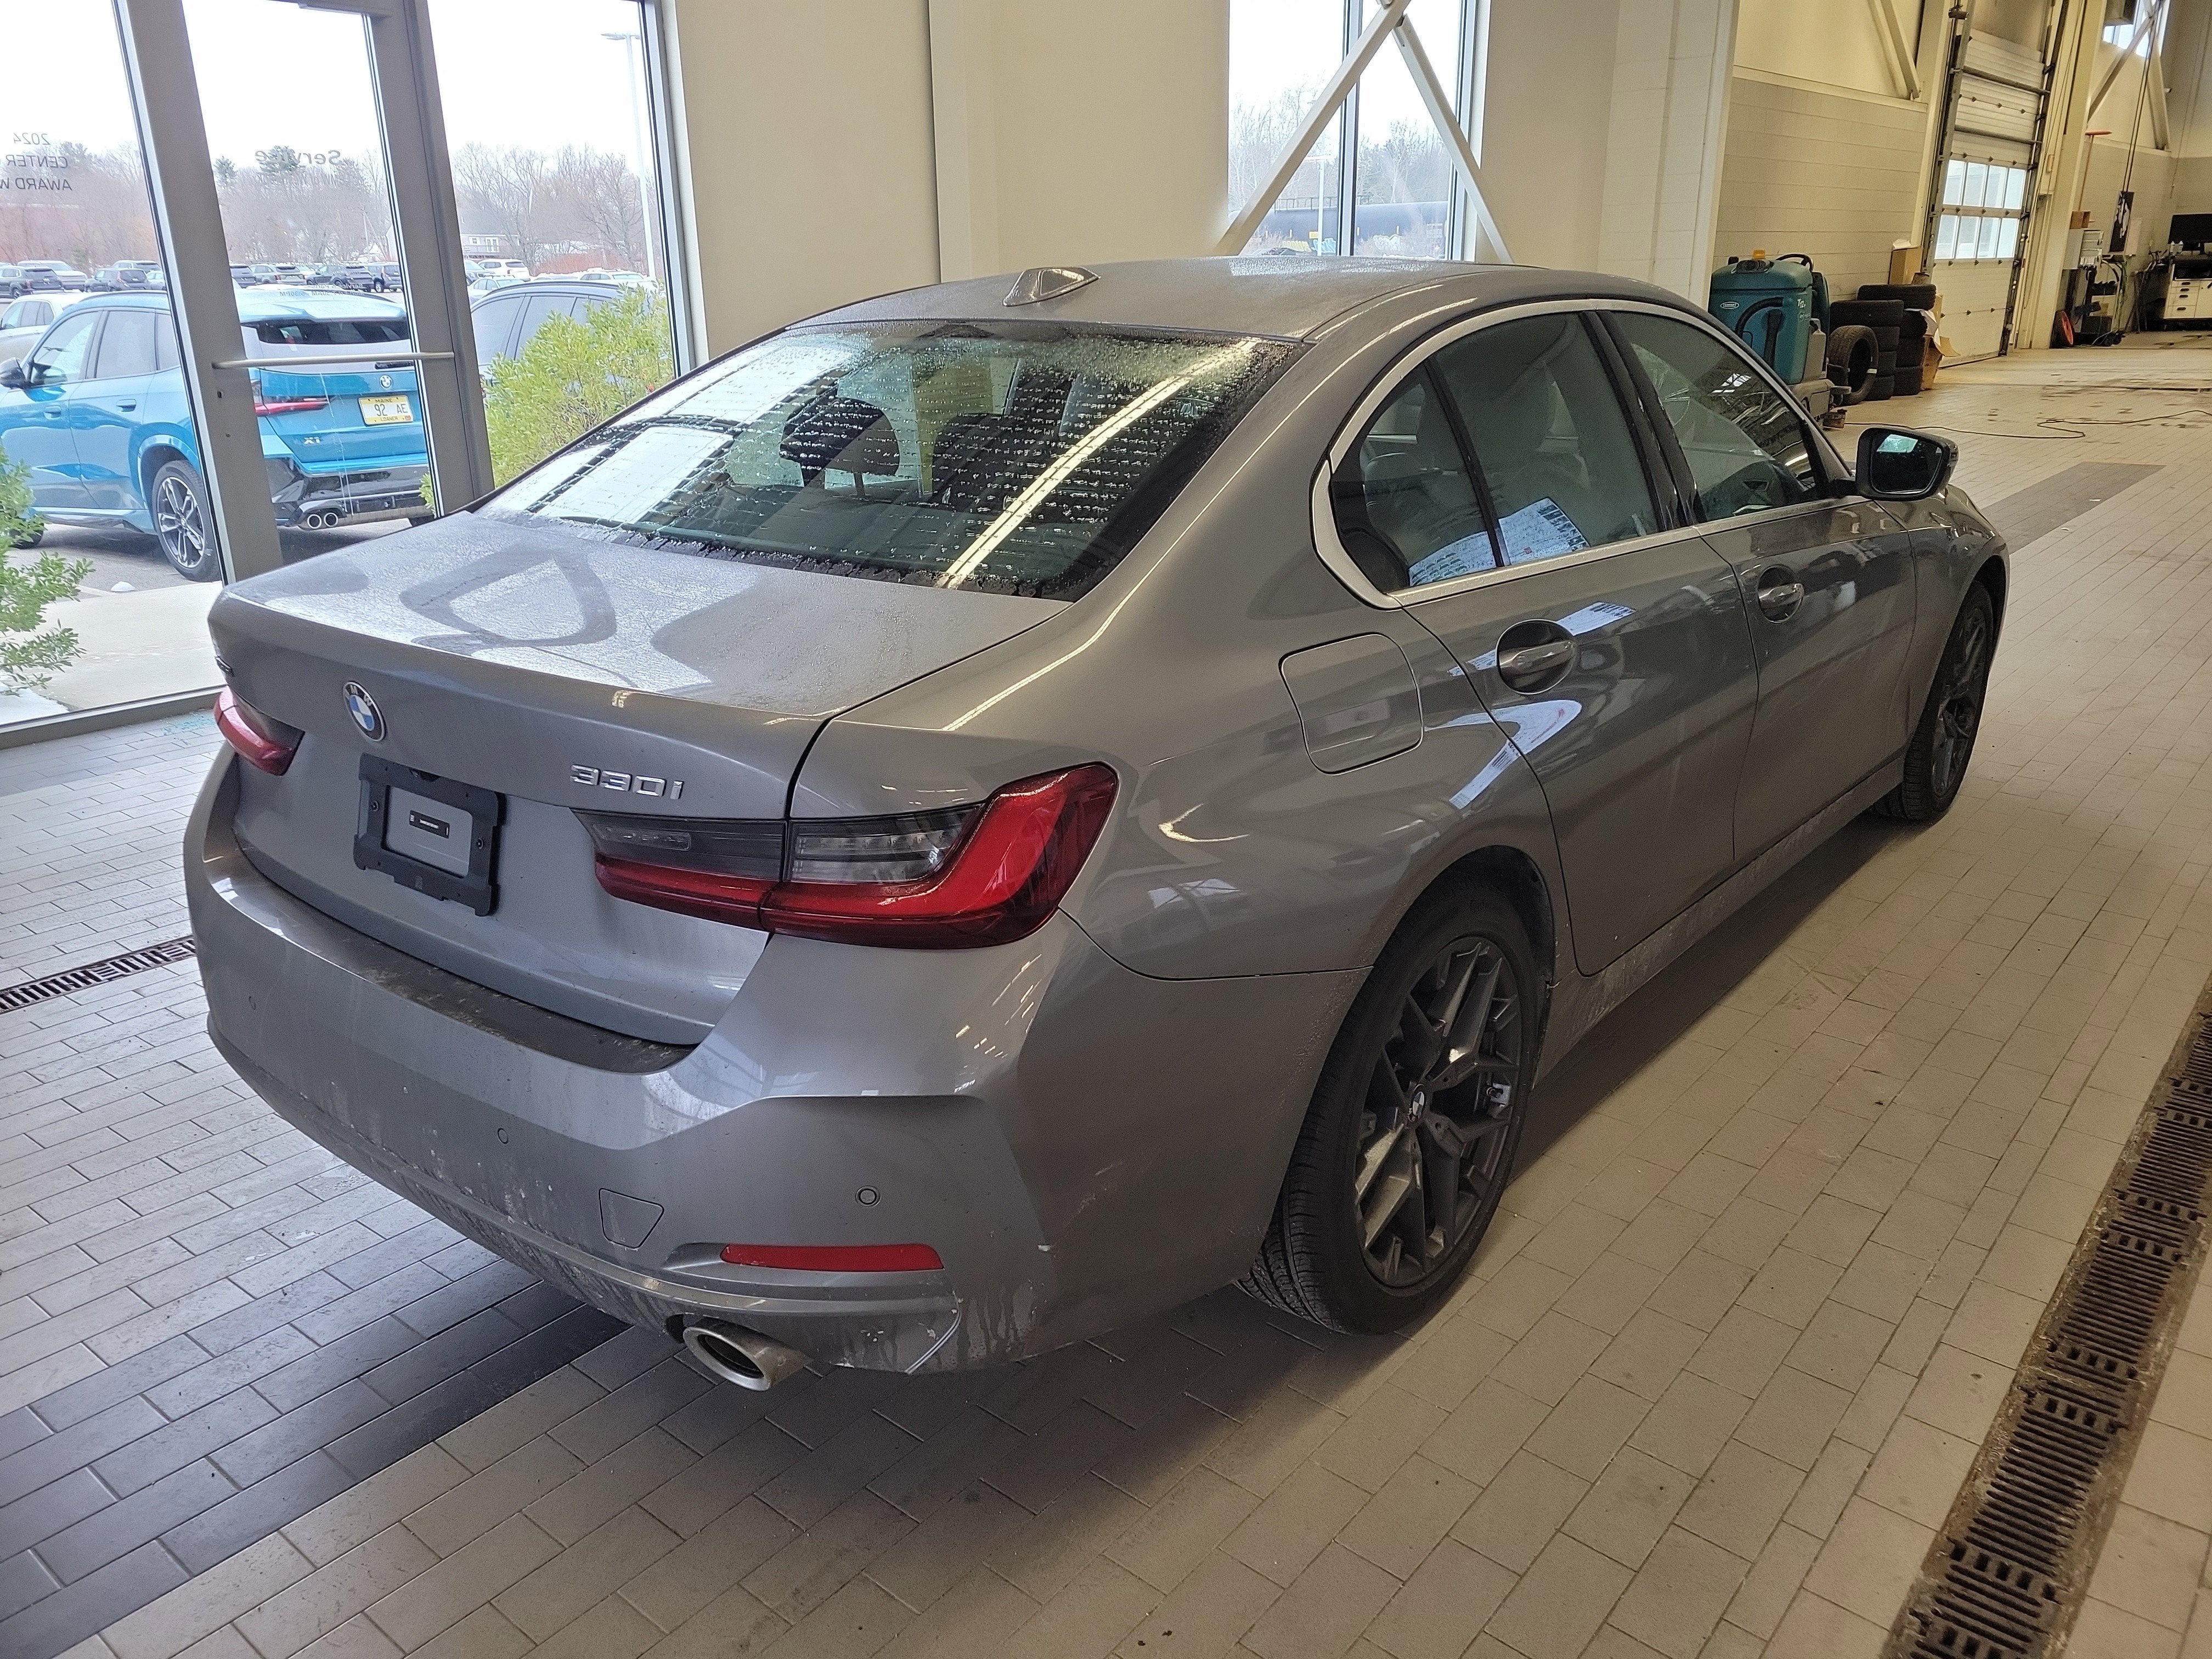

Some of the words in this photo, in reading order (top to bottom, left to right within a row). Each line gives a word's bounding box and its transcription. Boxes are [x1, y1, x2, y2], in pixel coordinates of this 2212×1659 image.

[374, 404, 387, 416] 92
[396, 404, 408, 414] AE
[303, 436, 320, 444] X1
[345, 684, 373, 707] BMW
[569, 764, 684, 800] 330i
